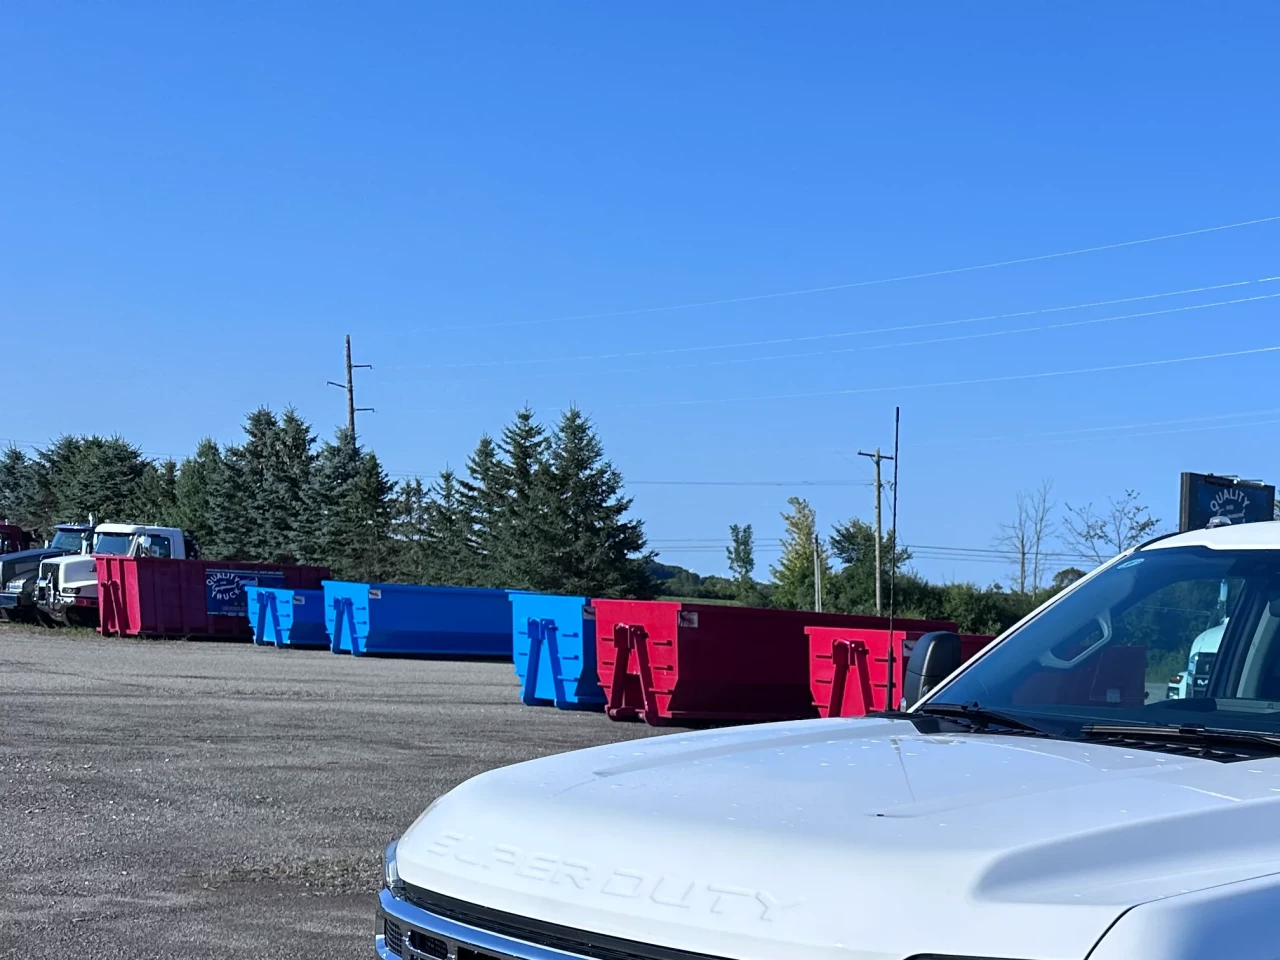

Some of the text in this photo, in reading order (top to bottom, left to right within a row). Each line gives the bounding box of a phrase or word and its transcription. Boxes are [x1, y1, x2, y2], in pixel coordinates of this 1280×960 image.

[1210, 488, 1250, 512] QUALITY
[206, 572, 241, 586] QUALITY
[211, 588, 241, 600] TRUCK
[599, 866, 806, 922] DUTY
